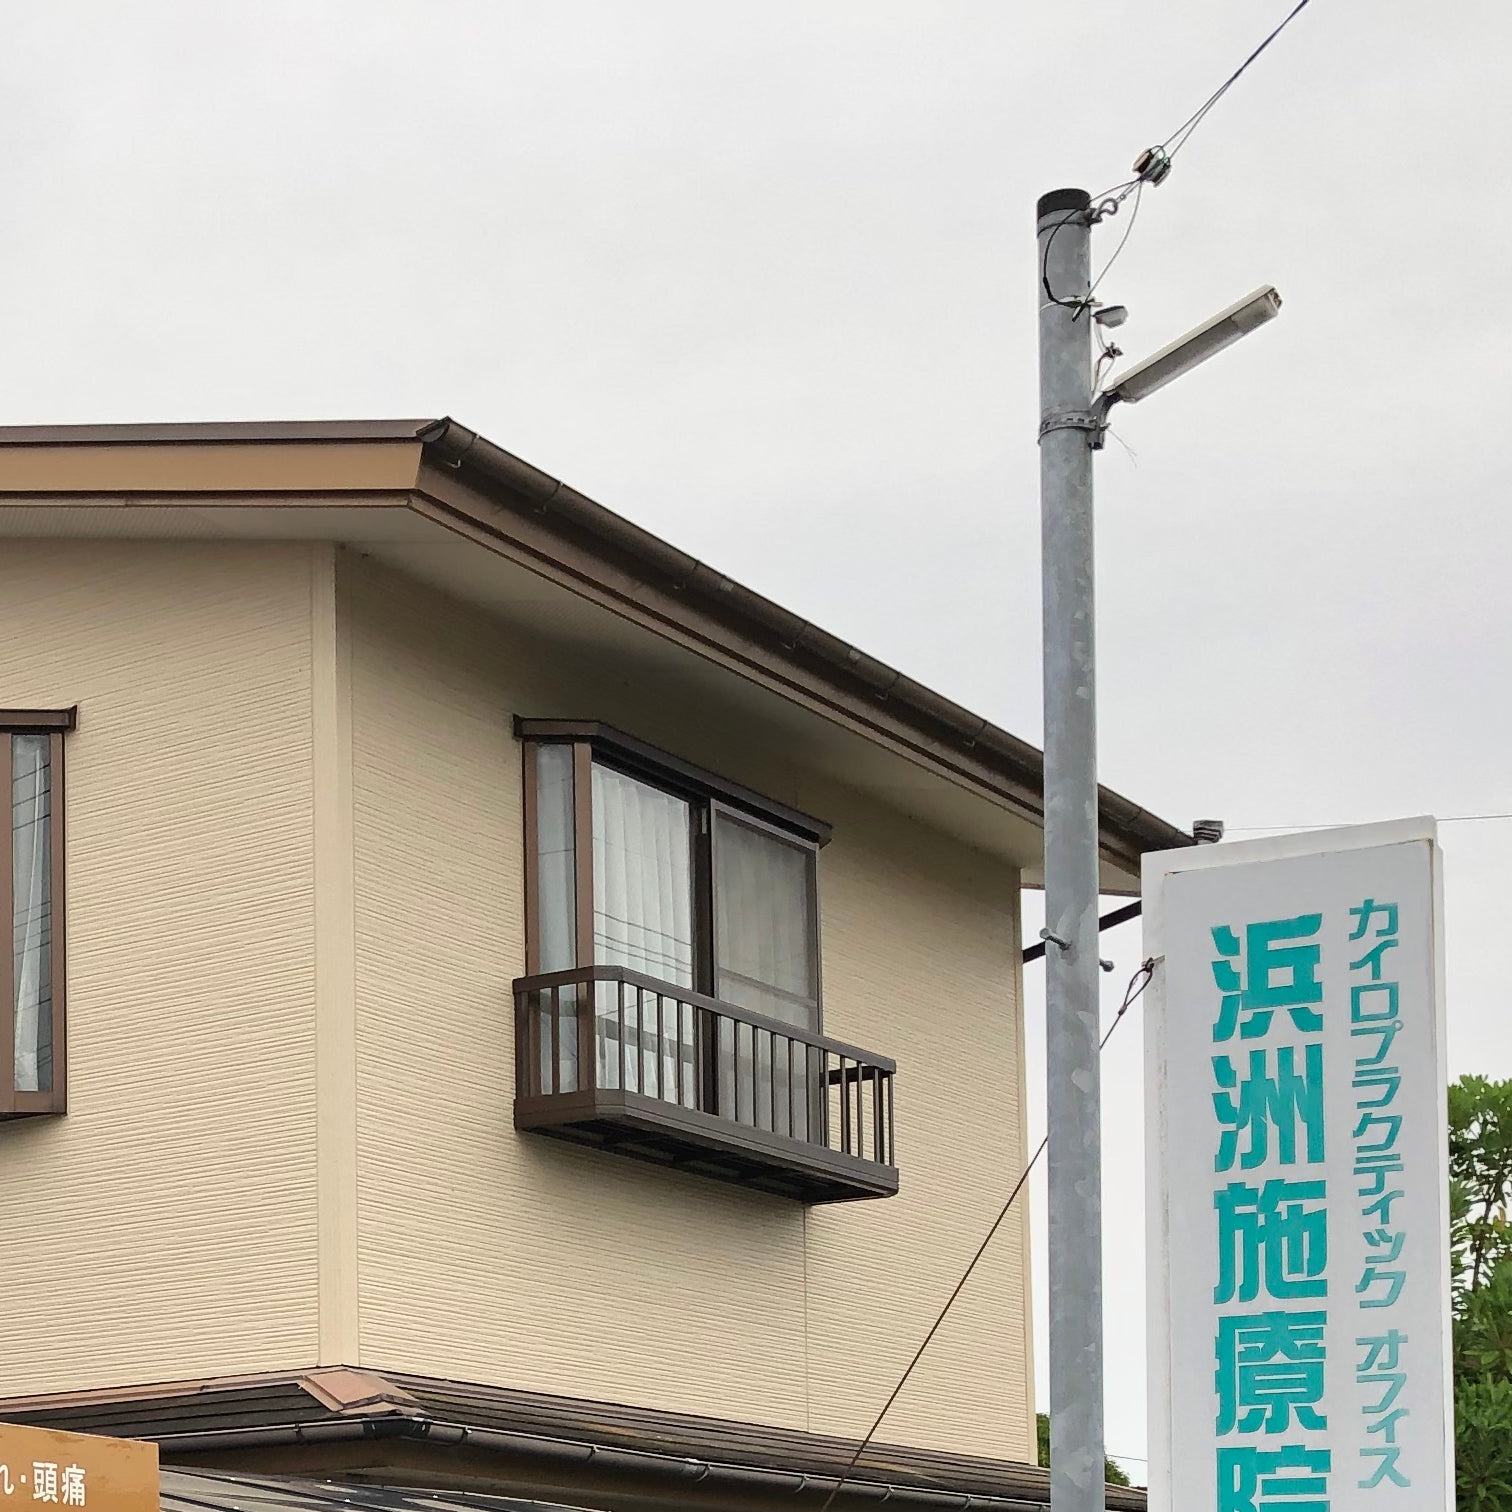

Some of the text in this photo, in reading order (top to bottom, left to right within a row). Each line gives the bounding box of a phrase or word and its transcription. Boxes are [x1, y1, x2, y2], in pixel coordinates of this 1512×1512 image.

[1348, 897, 1410, 1489] カイロプラクティック オフィス
